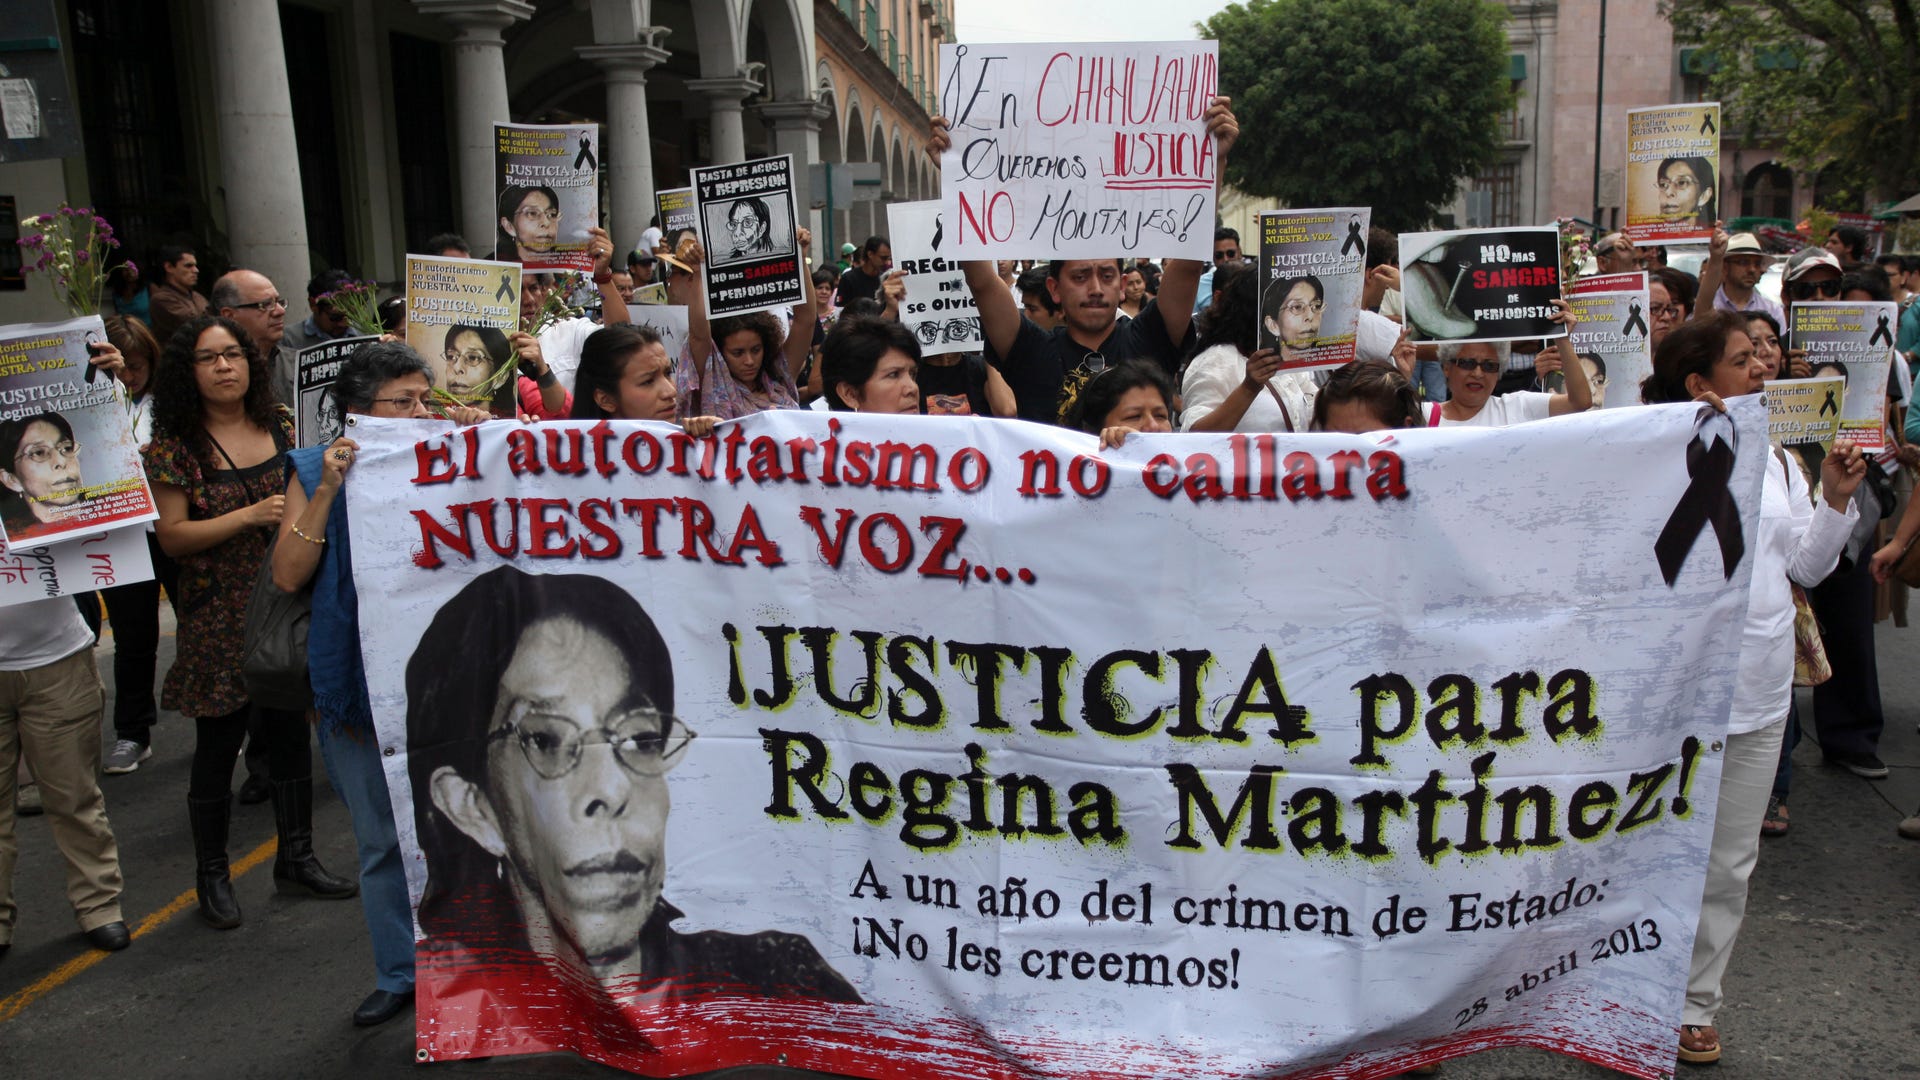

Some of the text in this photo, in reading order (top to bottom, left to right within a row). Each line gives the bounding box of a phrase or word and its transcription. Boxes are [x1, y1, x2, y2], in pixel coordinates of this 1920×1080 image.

[1036, 52, 1216, 127] CHIHUAHUA
[499, 128, 566, 140] El autoritarismo
[1631, 126, 1670, 137] NUESTRA
[499, 146, 543, 155] NUESTRA
[1100, 132, 1214, 179] JUSTICIA
[573, 168, 595, 178] para
[699, 160, 787, 183] BASTA DE ACOSO
[505, 175, 543, 188] Regina
[702, 173, 787, 198] Y REPRESION
[958, 190, 1015, 245] NO
[1266, 215, 1334, 226] El autoritarismo
[1265, 235, 1309, 244] NUESTRA
[1271, 252, 1362, 267] ¡JUSTICIA para
[1480, 245, 1511, 264] NO
[412, 263, 488, 276] El autoritarismo
[711, 272, 727, 284] NO
[744, 261, 795, 280] SANGRE
[1271, 267, 1308, 281] Regina
[1472, 267, 1557, 289] SANGRE
[412, 281, 460, 293] NUESTRA
[719, 278, 799, 301] PERIODISTAS
[1507, 293, 1520, 303] DE
[481, 305, 510, 316] para
[907, 303, 926, 314] se
[1474, 305, 1560, 321] PERIODISTAS
[1808, 308, 1865, 316] autoritarismo
[410, 310, 455, 327] Regina
[1796, 324, 1840, 332] NUESTRA
[1621, 335, 1645, 343] para
[301, 350, 325, 366] BASTA
[327, 346, 338, 359] DE
[301, 371, 308, 384] Y
[0, 380, 114, 405] USTICIA para
[1806, 421, 1831, 433] para
[410, 417, 1411, 503] El autoritarismo no callará
[105, 493, 123, 503] Plaza
[63, 507, 93, 518] Domingo
[104, 502, 112, 510] de
[113, 499, 128, 508] abril
[410, 497, 1035, 583] NUESTRA VOZ...
[721, 622, 1601, 769] ¡JUSTICIA para
[758, 727, 1701, 865] Regina Martínez!
[850, 858, 1610, 941] A un año del crimen de Estado:
[852, 916, 1241, 990] ¡No les creemos!
[1454, 918, 1662, 1030] 28 abril 2013
